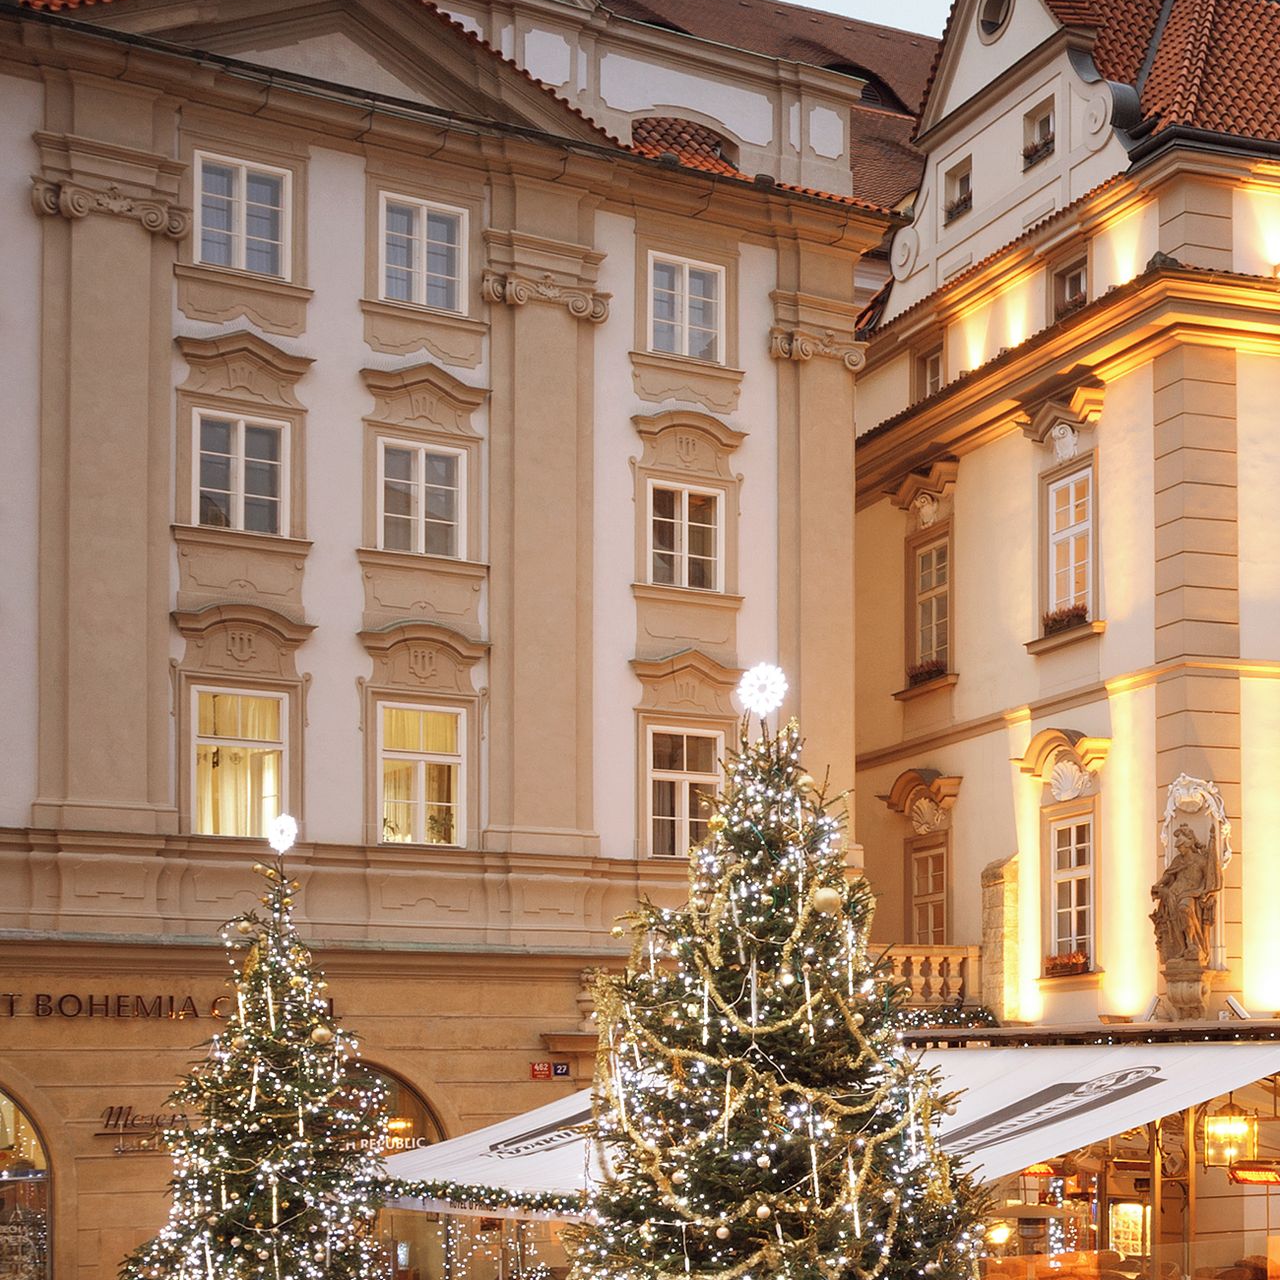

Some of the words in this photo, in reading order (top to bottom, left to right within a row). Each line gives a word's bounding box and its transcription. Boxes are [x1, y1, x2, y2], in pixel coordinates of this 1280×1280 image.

[35, 993, 199, 1019] BOHEMIA
[556, 1064, 567, 1074] 27
[360, 1136, 427, 1151] REPUBLIC
